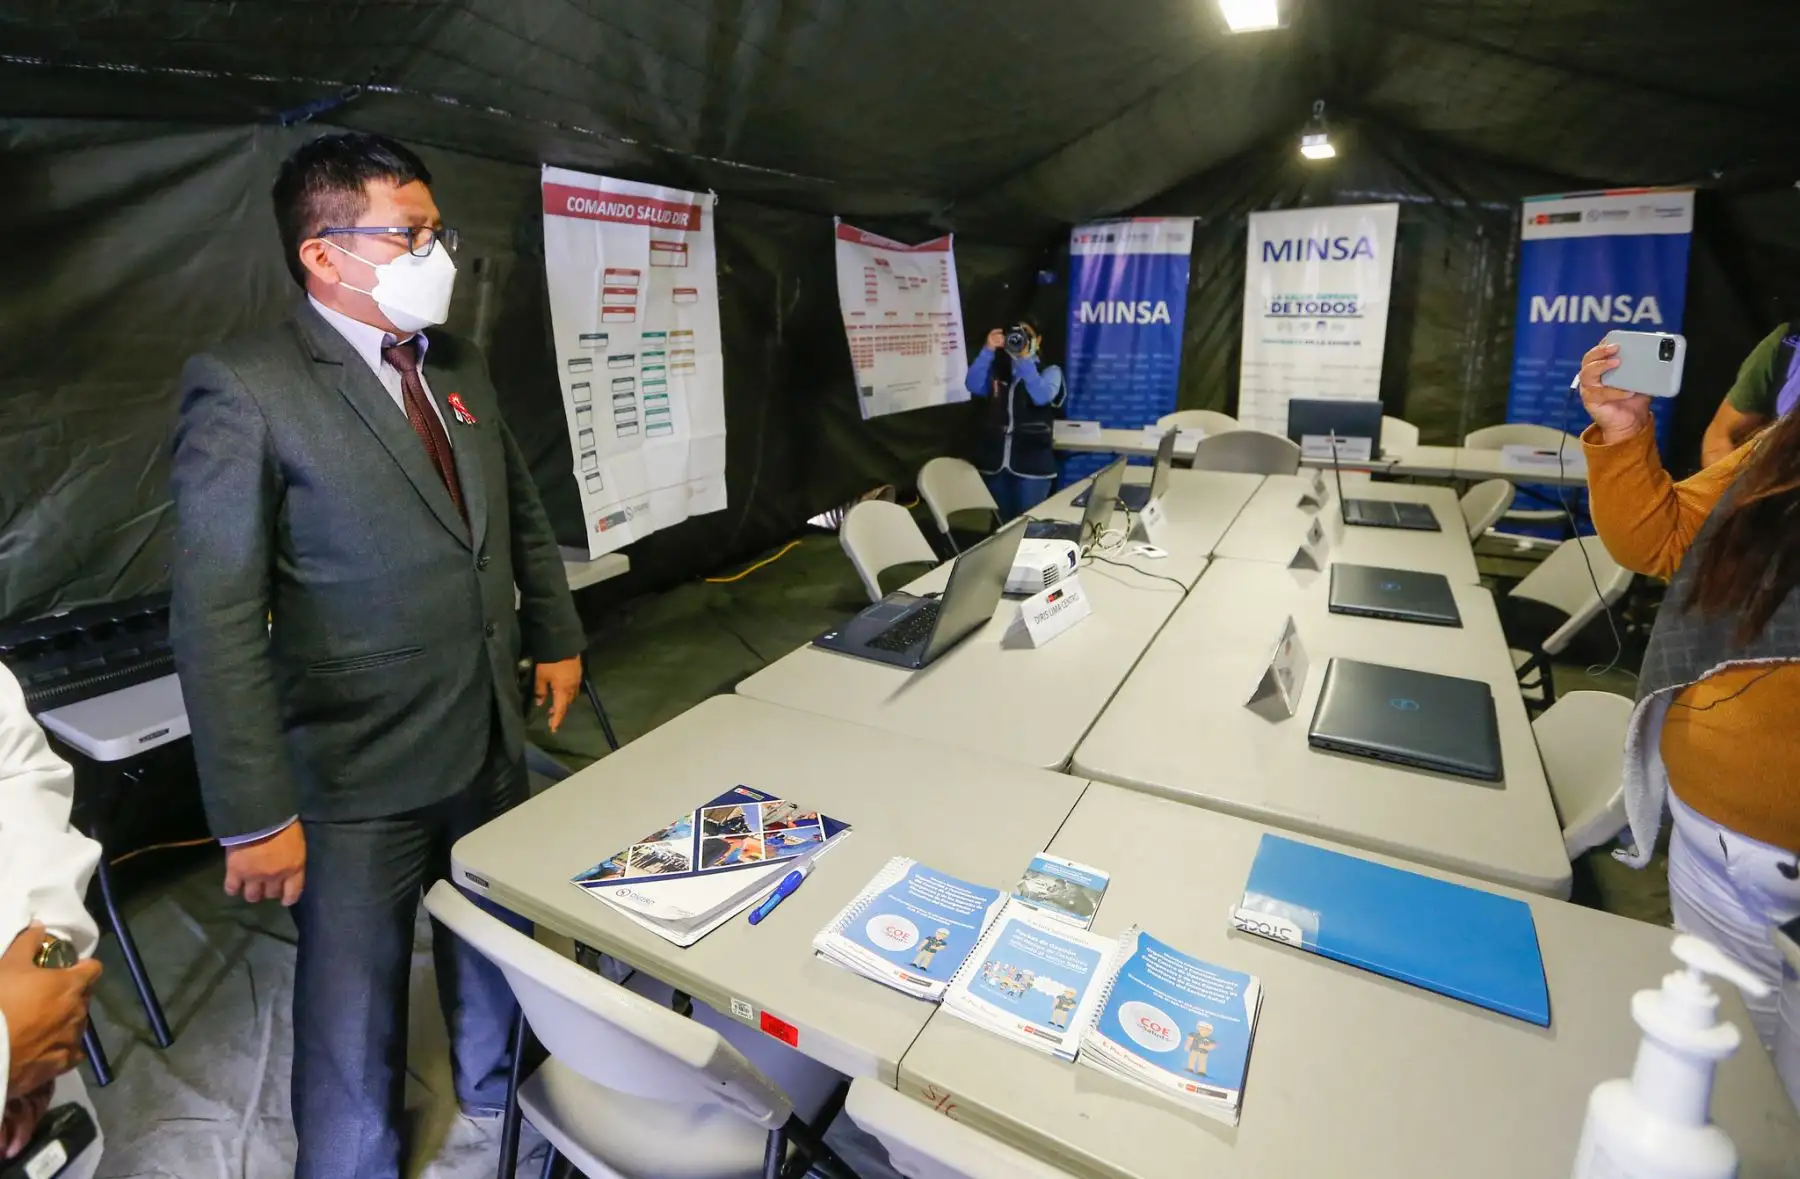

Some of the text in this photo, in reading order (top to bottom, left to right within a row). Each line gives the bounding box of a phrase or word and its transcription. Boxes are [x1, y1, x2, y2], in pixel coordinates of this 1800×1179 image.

[566, 196, 689, 226] COMANDO SALUD DIR
[1263, 236, 1374, 262] MINSA
[1080, 300, 1171, 325] MINSA
[1271, 302, 1357, 314] DE TODOS
[1529, 295, 1663, 324] MINSA
[1033, 592, 1080, 625] DIRIS LIMA CENTRO
[885, 926, 911, 940] COE
[1140, 1017, 1171, 1037] COE
